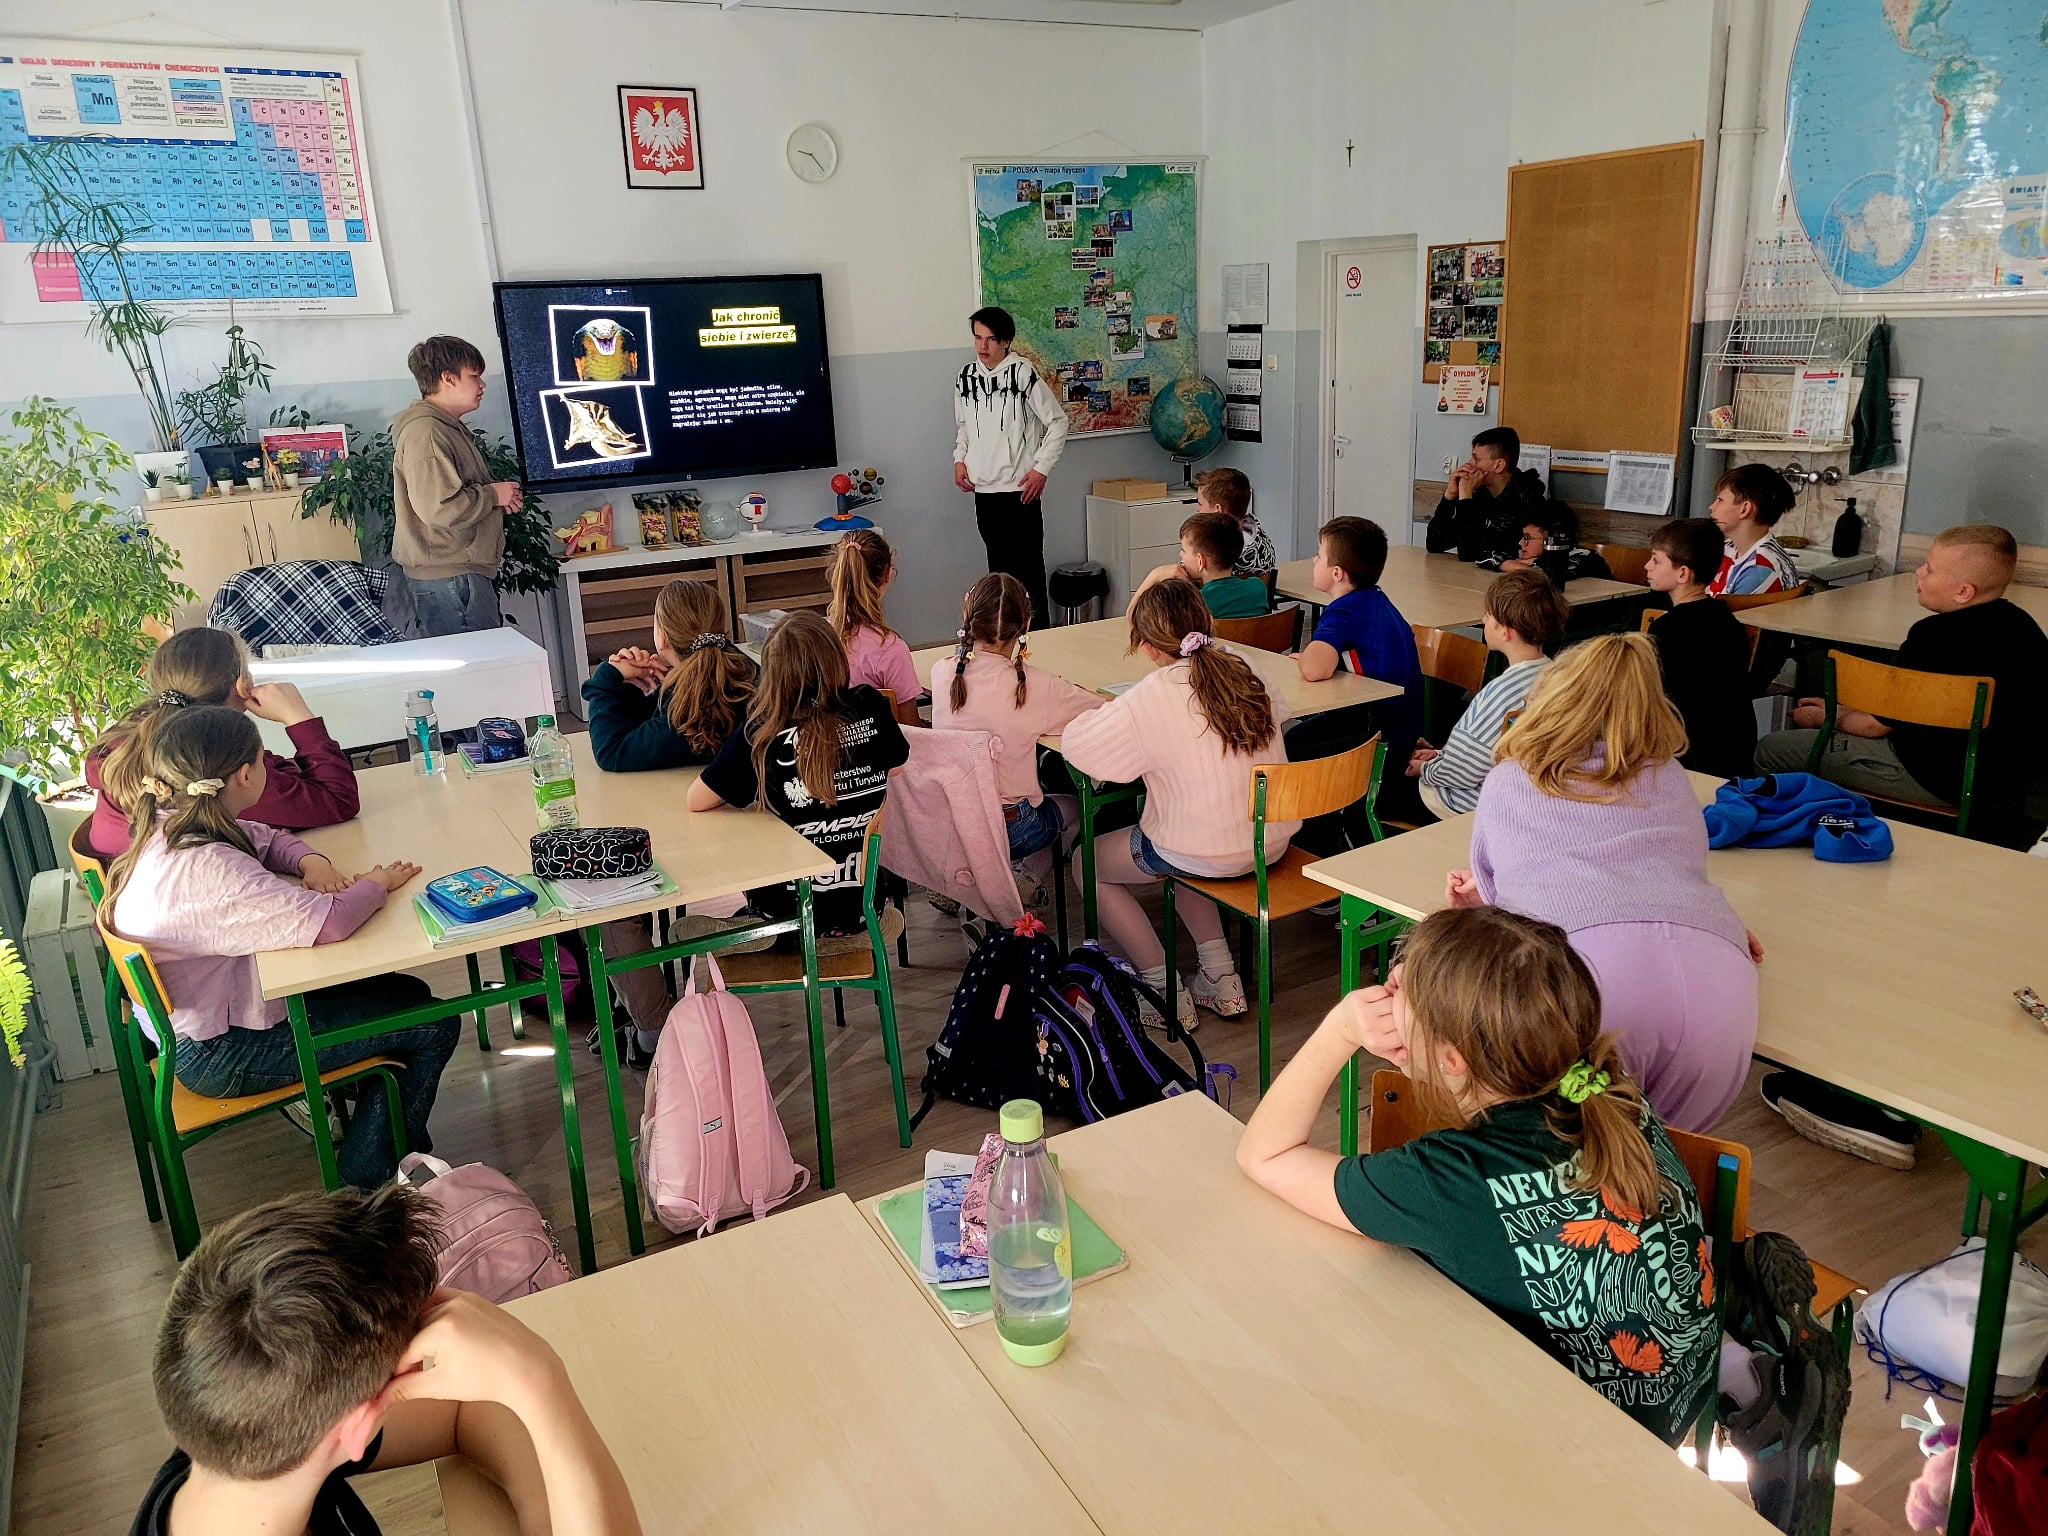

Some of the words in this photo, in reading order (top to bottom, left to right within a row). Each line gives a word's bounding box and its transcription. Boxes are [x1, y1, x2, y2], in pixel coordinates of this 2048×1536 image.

[92, 92, 113, 105] Mn
[1012, 166, 1039, 174] POLSKA
[712, 312, 733, 323] Jak
[737, 309, 780, 322] chronić
[701, 331, 736, 343] siebie
[740, 331, 743, 341] i
[747, 329, 796, 342] zwierzę?
[833, 765, 872, 780] isterstwo
[853, 770, 886, 787] Turystyki
[793, 808, 880, 836] TEMPIS
[813, 830, 865, 844] FLOORBAL
